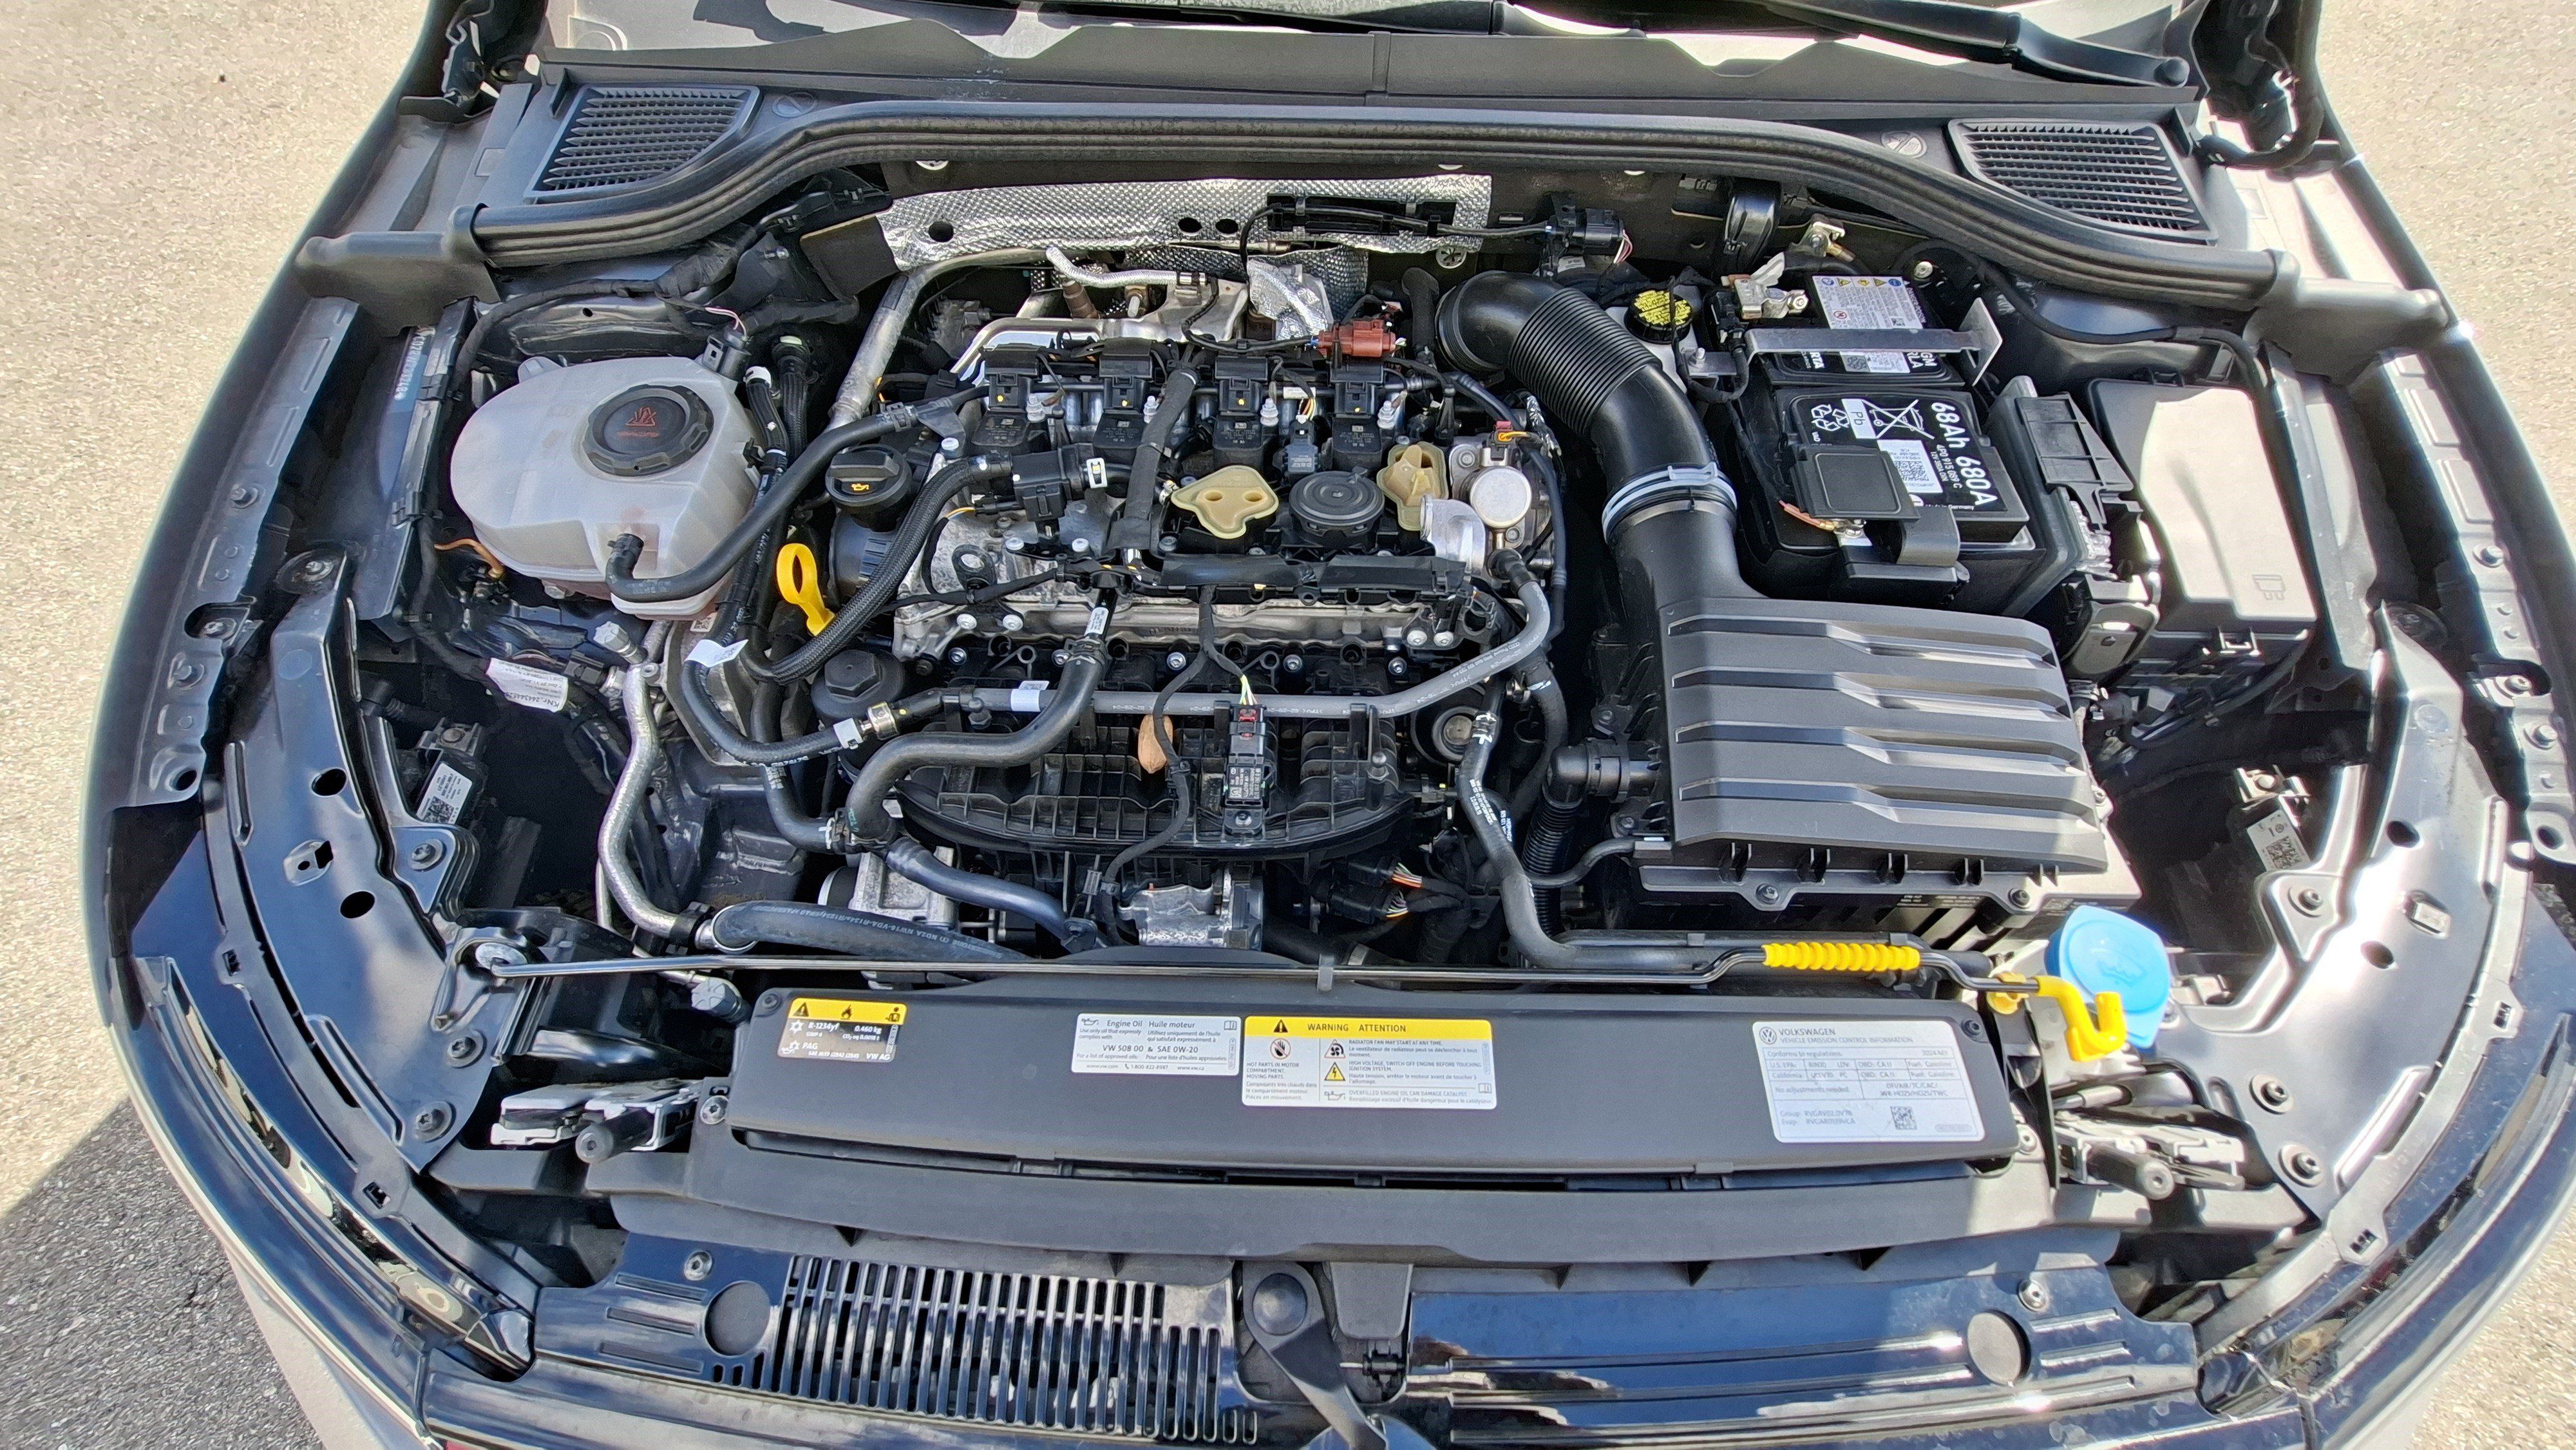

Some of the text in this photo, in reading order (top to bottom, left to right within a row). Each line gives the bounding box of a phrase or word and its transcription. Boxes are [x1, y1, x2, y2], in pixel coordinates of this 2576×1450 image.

[1810, 352, 1824, 369] RTA
[1920, 352, 1937, 367] GM
[1850, 411, 1863, 426] Pb
[1931, 402, 1998, 505] 68Ah 680A
[808, 1022, 840, 1032] R-1234yf
